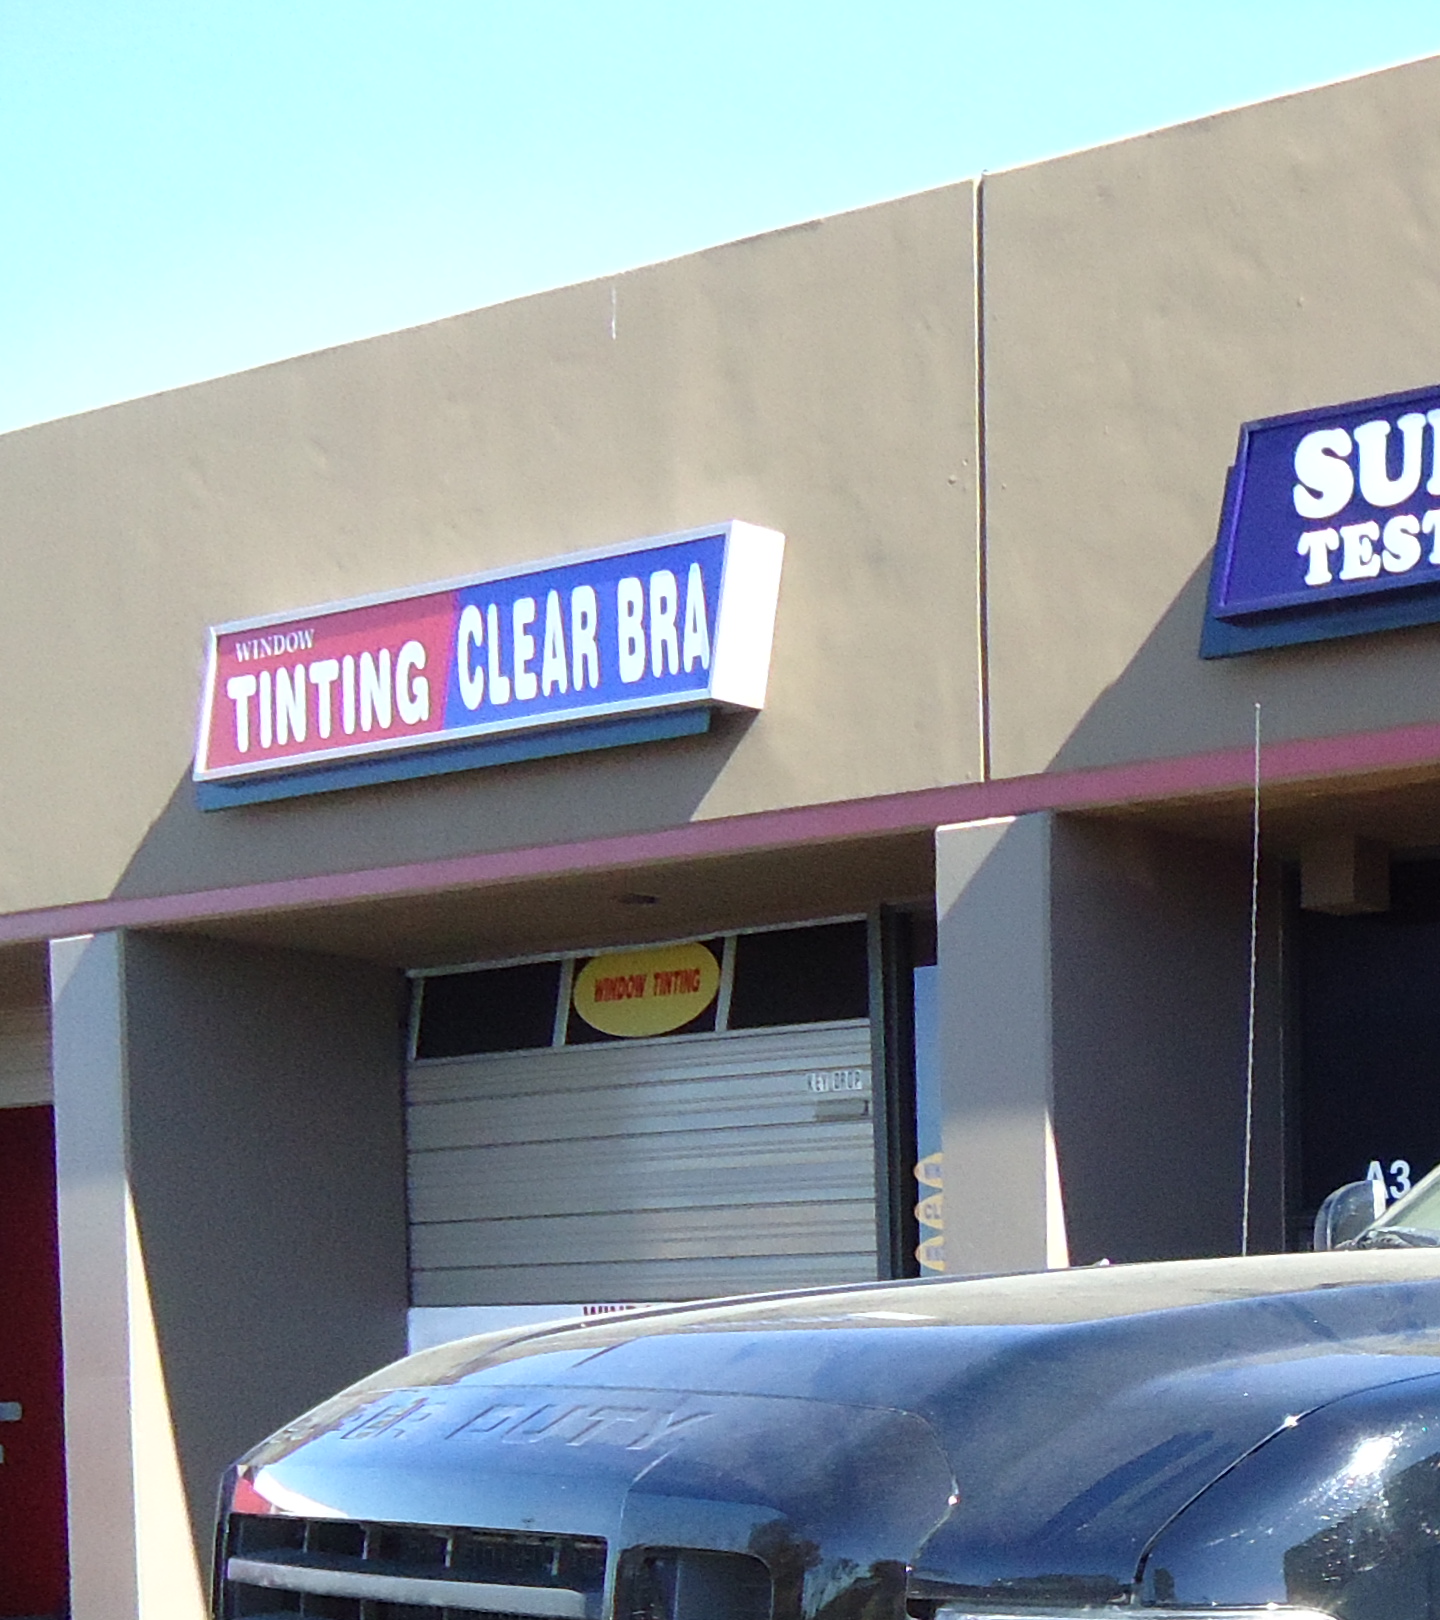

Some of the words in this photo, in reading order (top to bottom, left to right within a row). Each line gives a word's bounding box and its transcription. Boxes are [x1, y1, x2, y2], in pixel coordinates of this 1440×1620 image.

[235, 628, 315, 663] WINDOW
[457, 587, 600, 711] CLEAR
[616, 561, 710, 684] BRA
[226, 640, 430, 753] TINTING
[595, 974, 647, 1002] WINDOW
[653, 968, 701, 996] TINTING
[807, 1074, 828, 1091] KEY
[1366, 1160, 1411, 1199] A3
